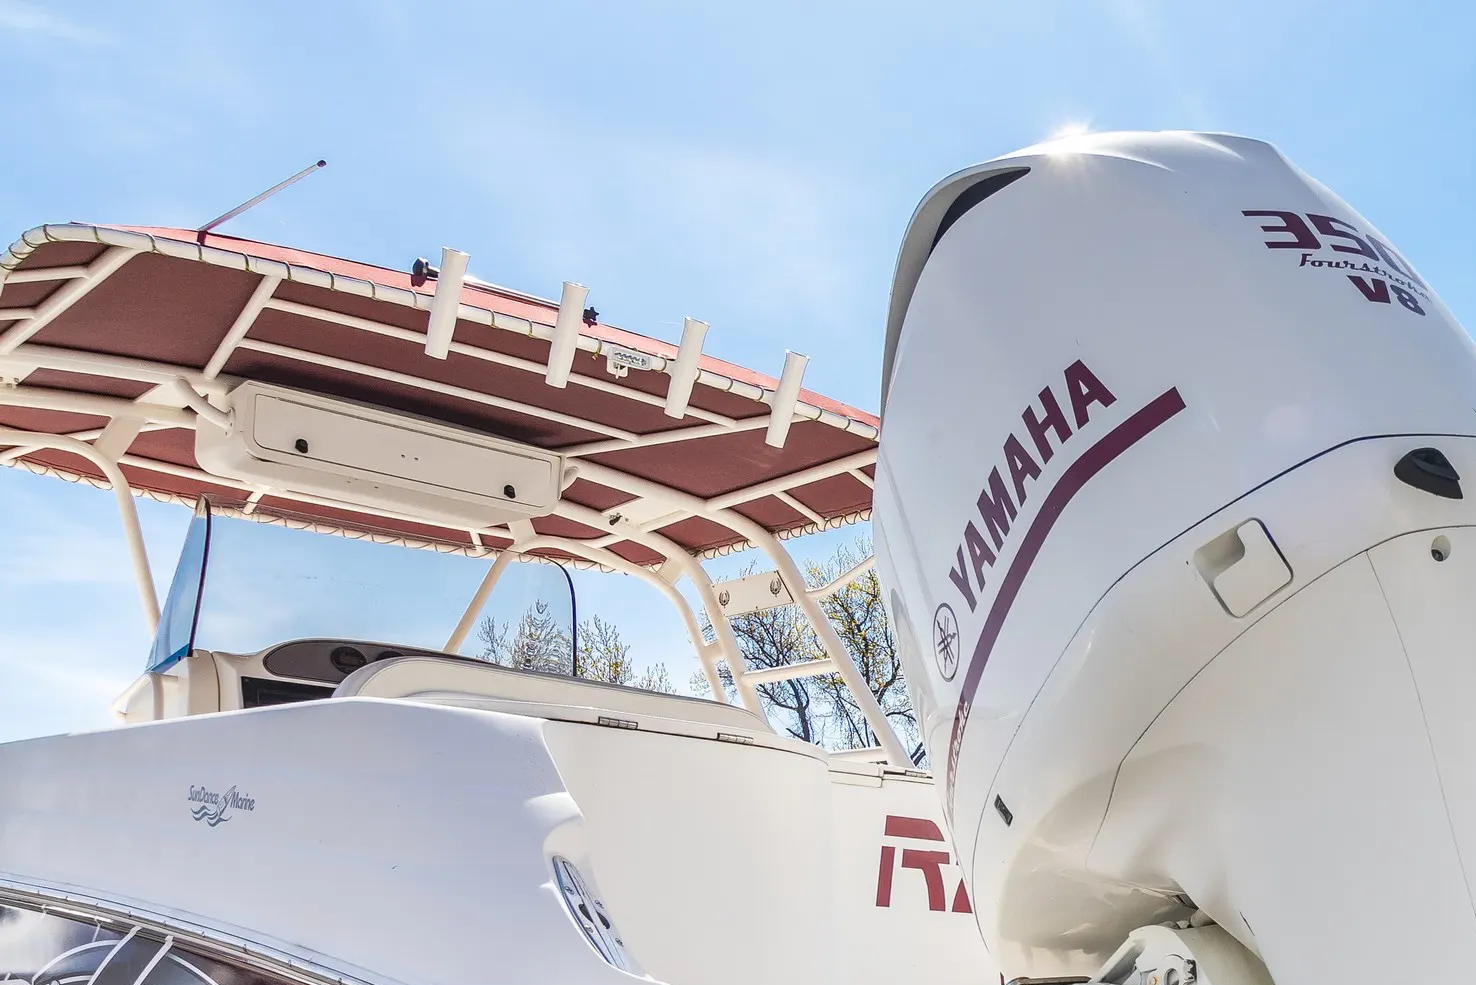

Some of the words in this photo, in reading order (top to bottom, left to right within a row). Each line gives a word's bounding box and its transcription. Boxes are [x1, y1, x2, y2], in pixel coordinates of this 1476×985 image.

[1241, 210, 1428, 291] 350
[1346, 274, 1426, 317] V8
[949, 359, 1118, 614] YAMAHA
[188, 784, 220, 805] SunDance
[229, 791, 256, 812] Marine
